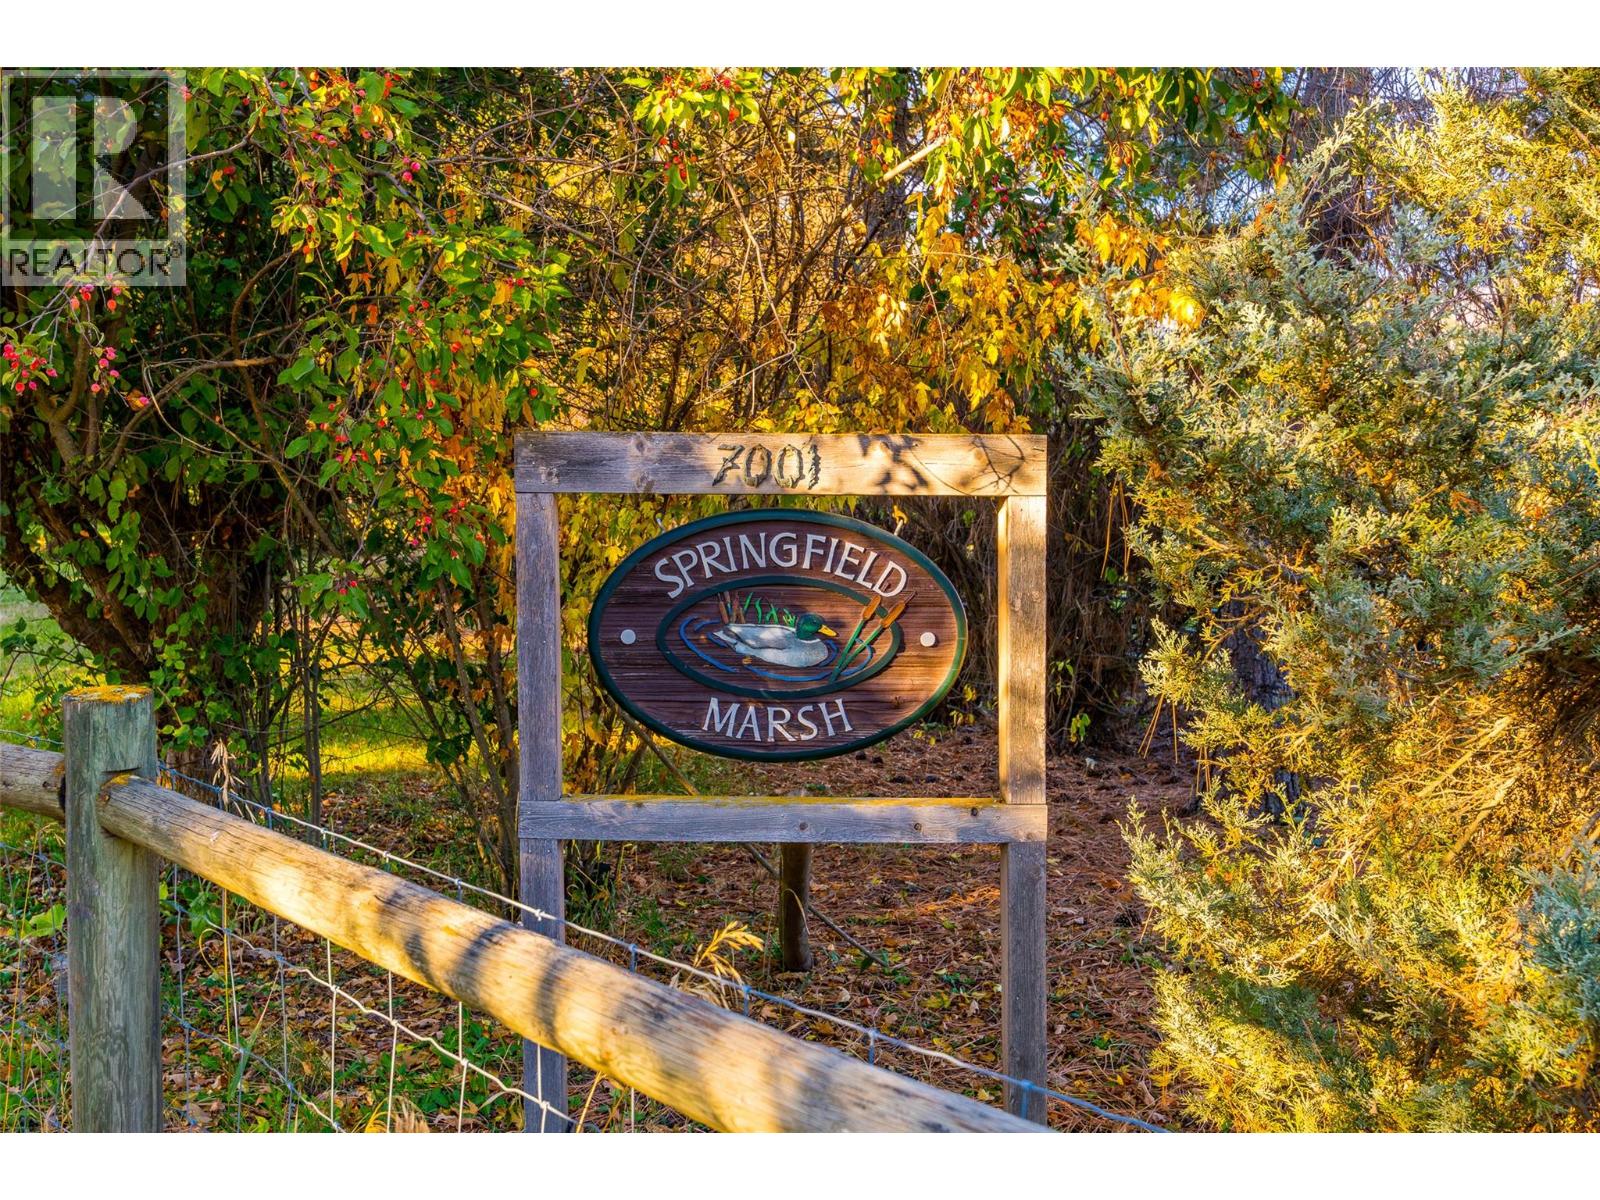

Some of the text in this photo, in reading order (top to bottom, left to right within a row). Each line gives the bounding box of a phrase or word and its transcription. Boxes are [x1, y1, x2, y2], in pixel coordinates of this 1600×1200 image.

[712, 443, 821, 490] 7001
[654, 532, 908, 598] SPRINGFIELD
[702, 697, 853, 742] MARSH
